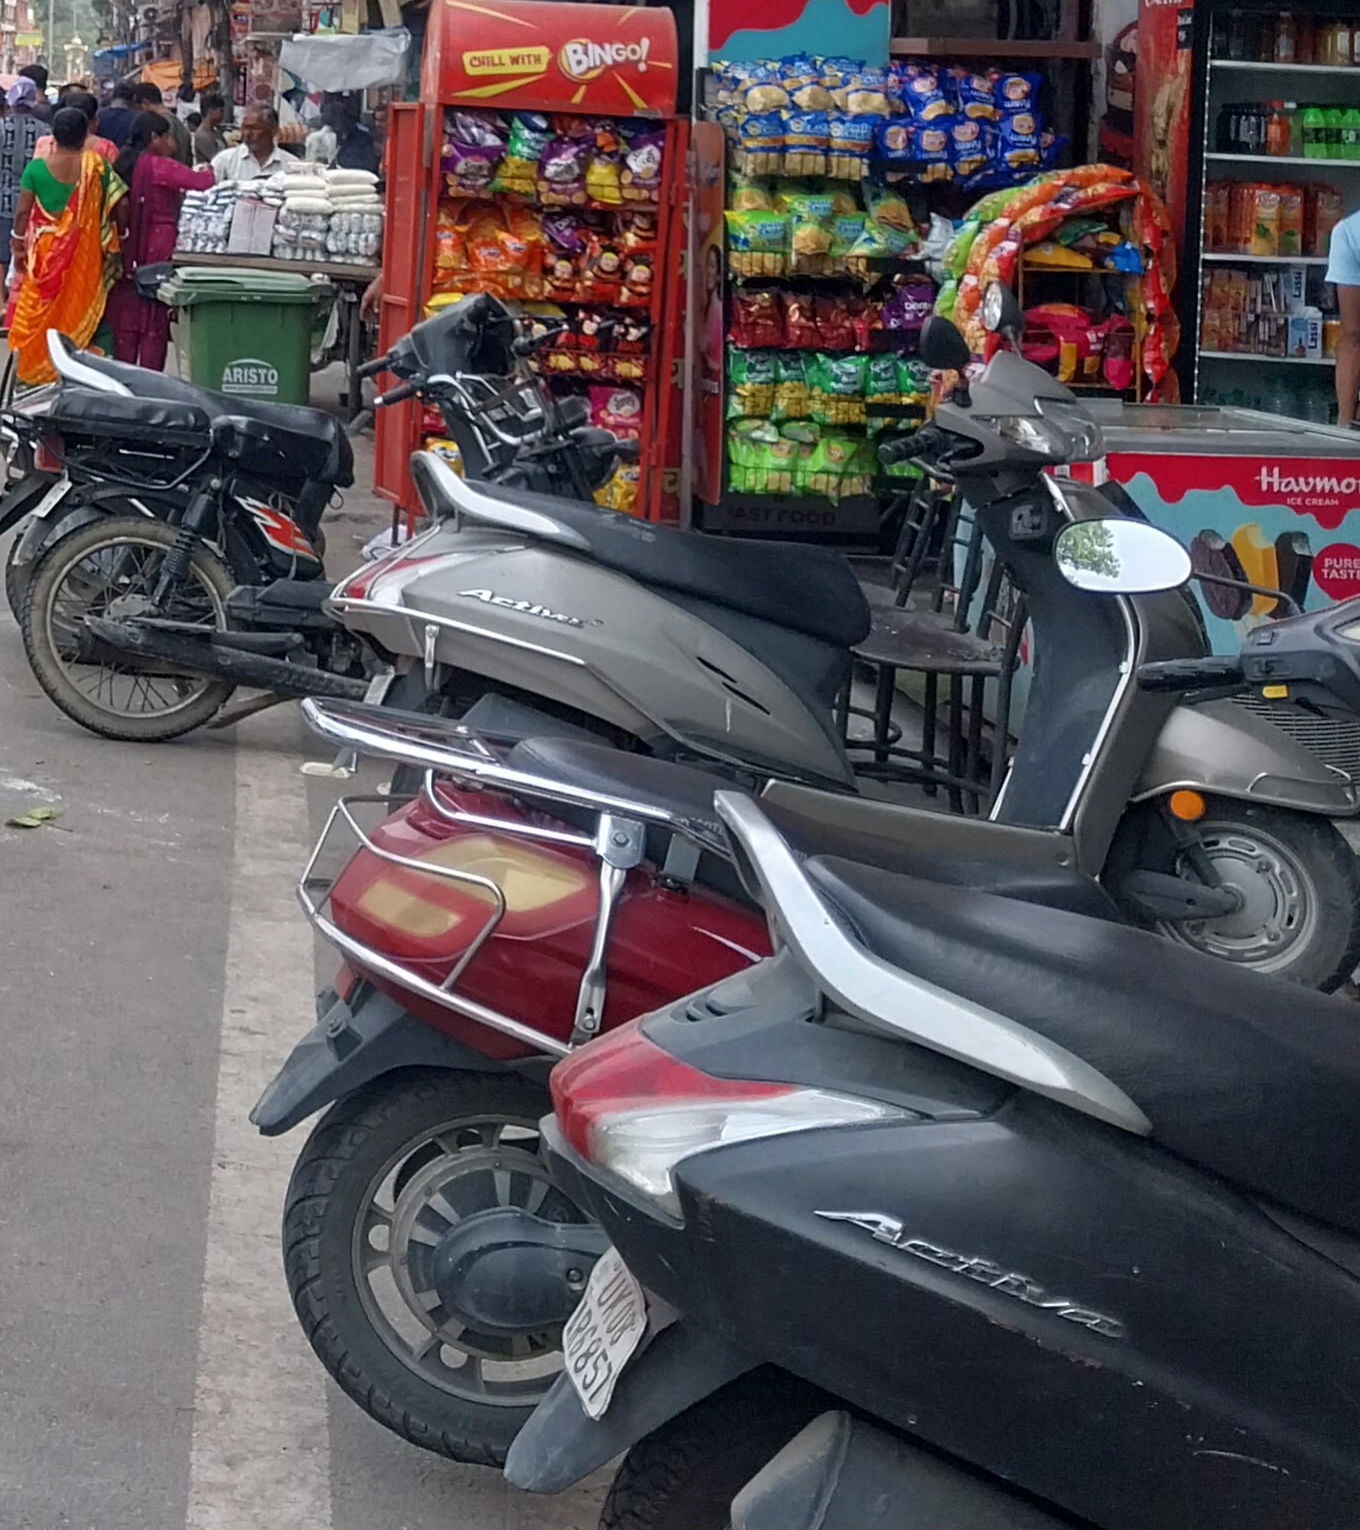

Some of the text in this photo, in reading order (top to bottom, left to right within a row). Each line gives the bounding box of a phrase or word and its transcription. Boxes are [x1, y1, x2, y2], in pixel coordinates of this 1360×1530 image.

[469, 53, 542, 69] CHILL WITH
[1308, 321, 1319, 350] Lassi
[223, 367, 278, 384] ARISTO
[1287, 497, 1340, 506] ICE CREAM
